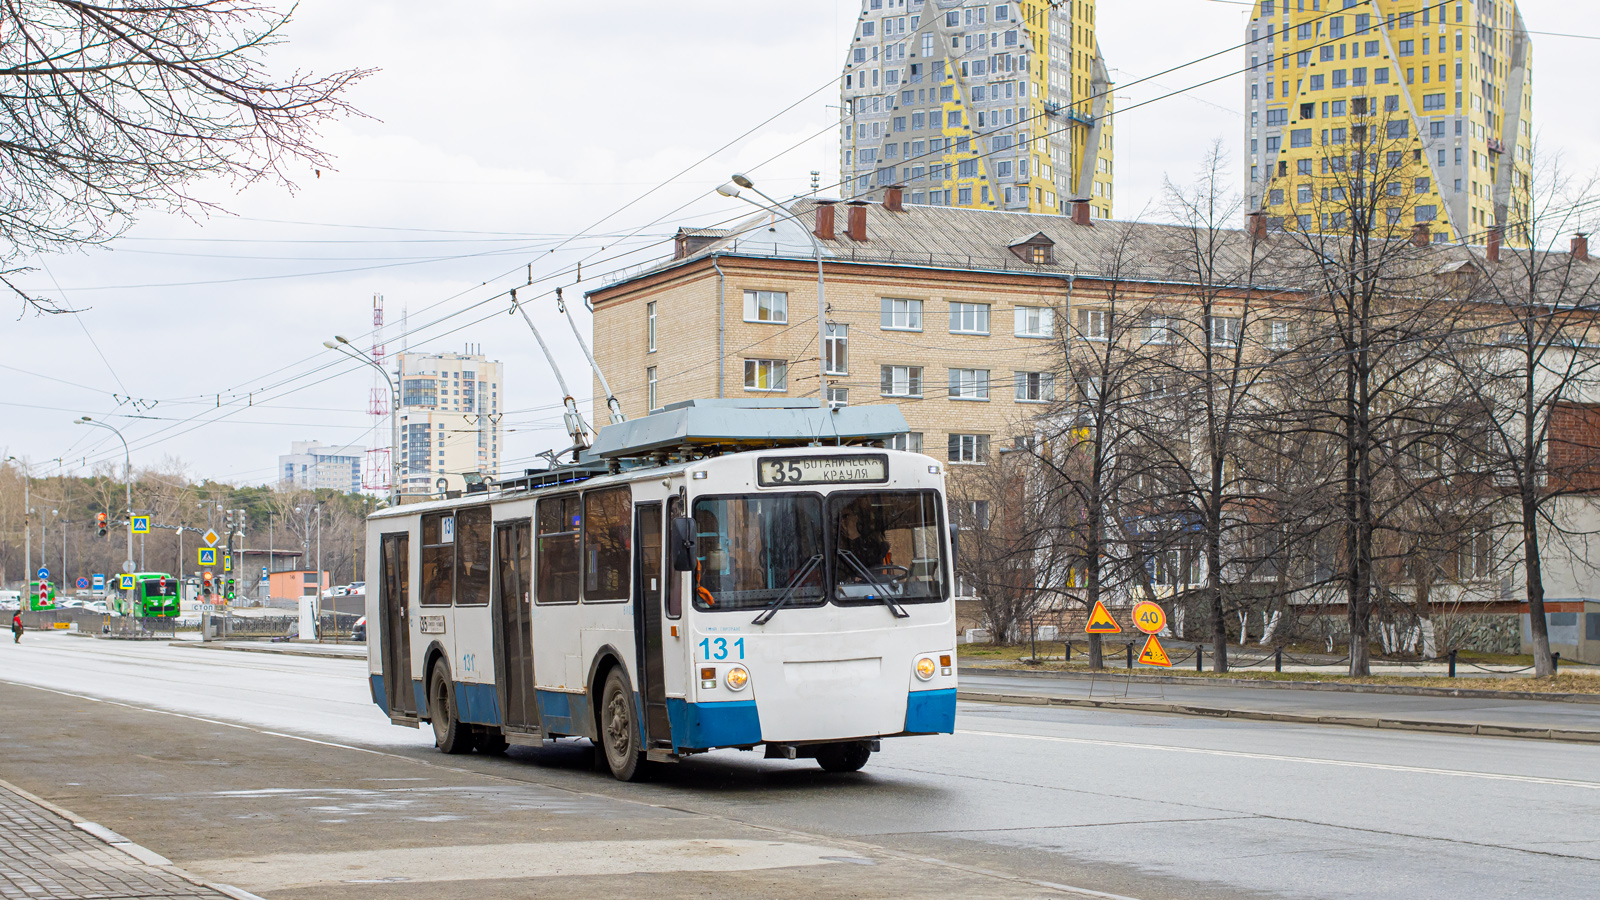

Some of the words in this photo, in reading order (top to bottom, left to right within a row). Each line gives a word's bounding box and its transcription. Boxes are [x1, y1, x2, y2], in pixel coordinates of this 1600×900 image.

[770, 460, 803, 482] 35
[823, 469, 868, 481] КРАУЛЯ
[444, 517, 454, 534] 131
[420, 616, 428, 632] 35
[1140, 611, 1158, 624] 40
[699, 637, 744, 660] 131
[463, 654, 474, 672] 131
